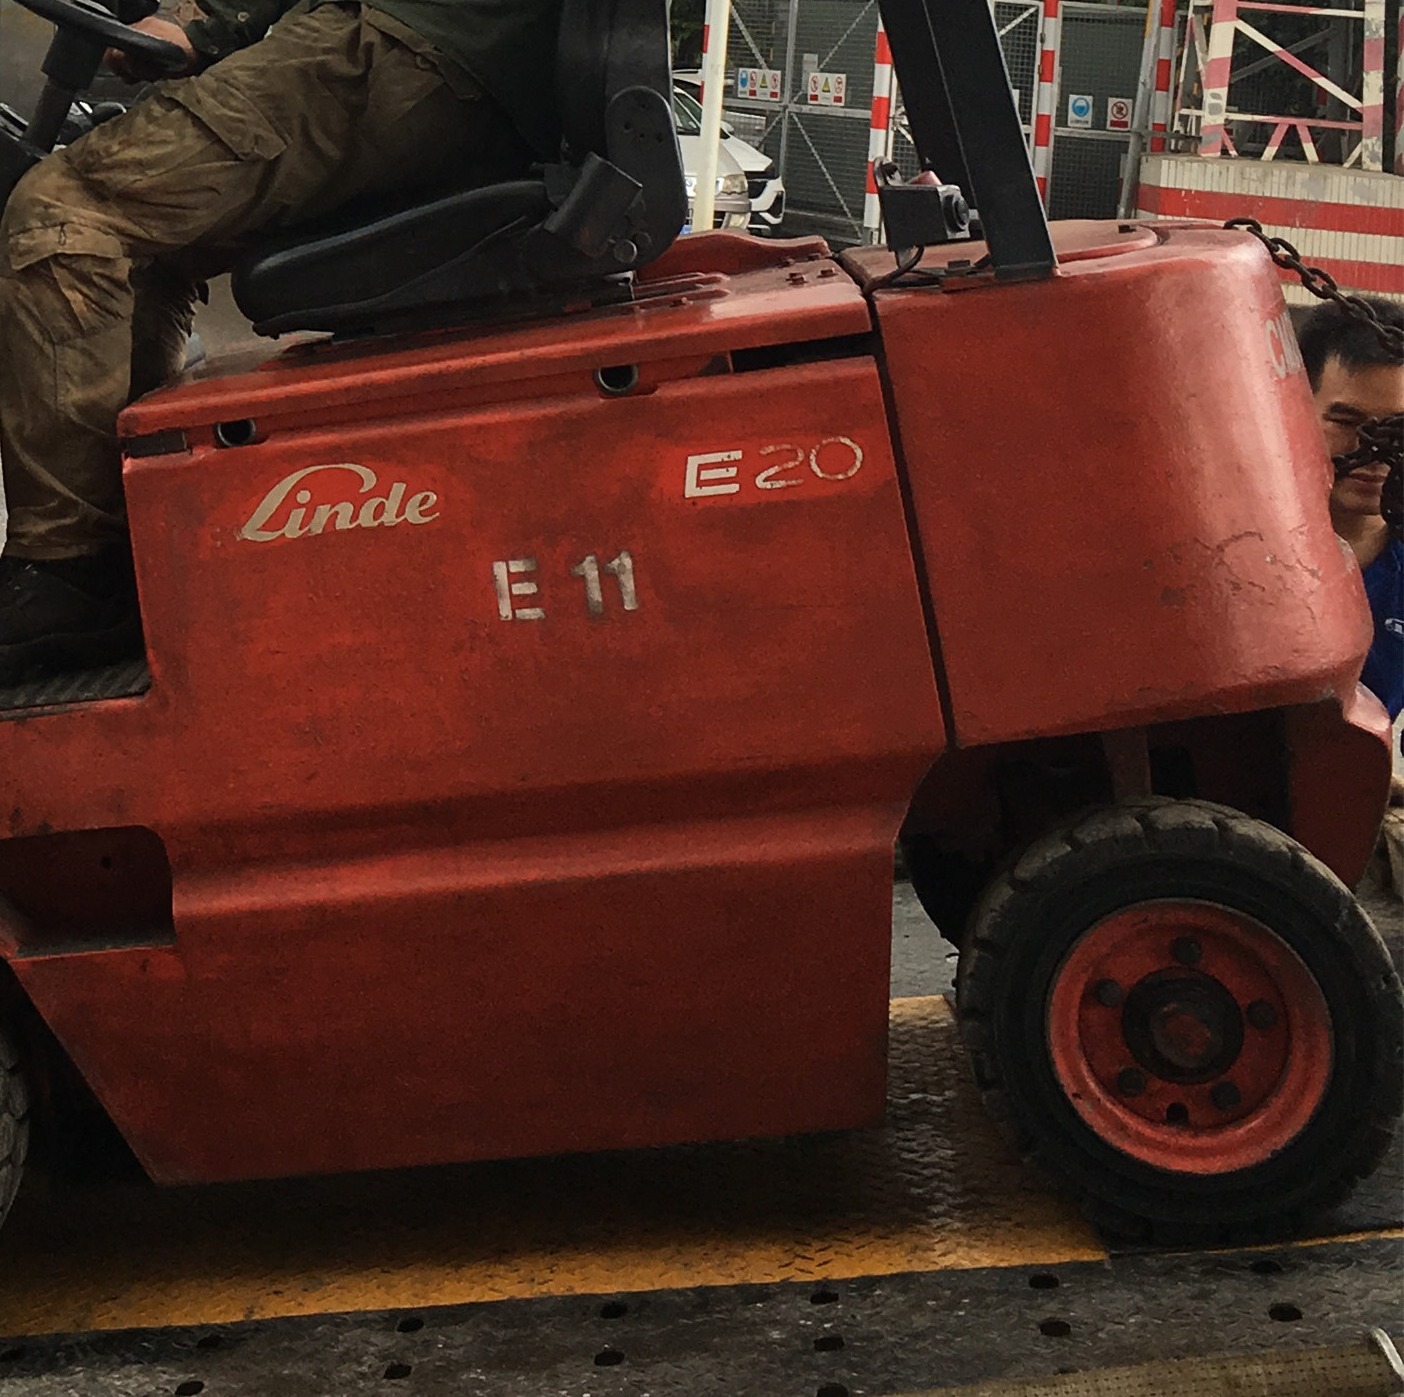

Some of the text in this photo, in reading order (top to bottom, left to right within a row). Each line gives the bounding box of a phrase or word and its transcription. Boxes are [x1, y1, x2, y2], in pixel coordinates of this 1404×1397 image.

[236, 463, 440, 542] Linde
[492, 551, 639, 620] E 11
